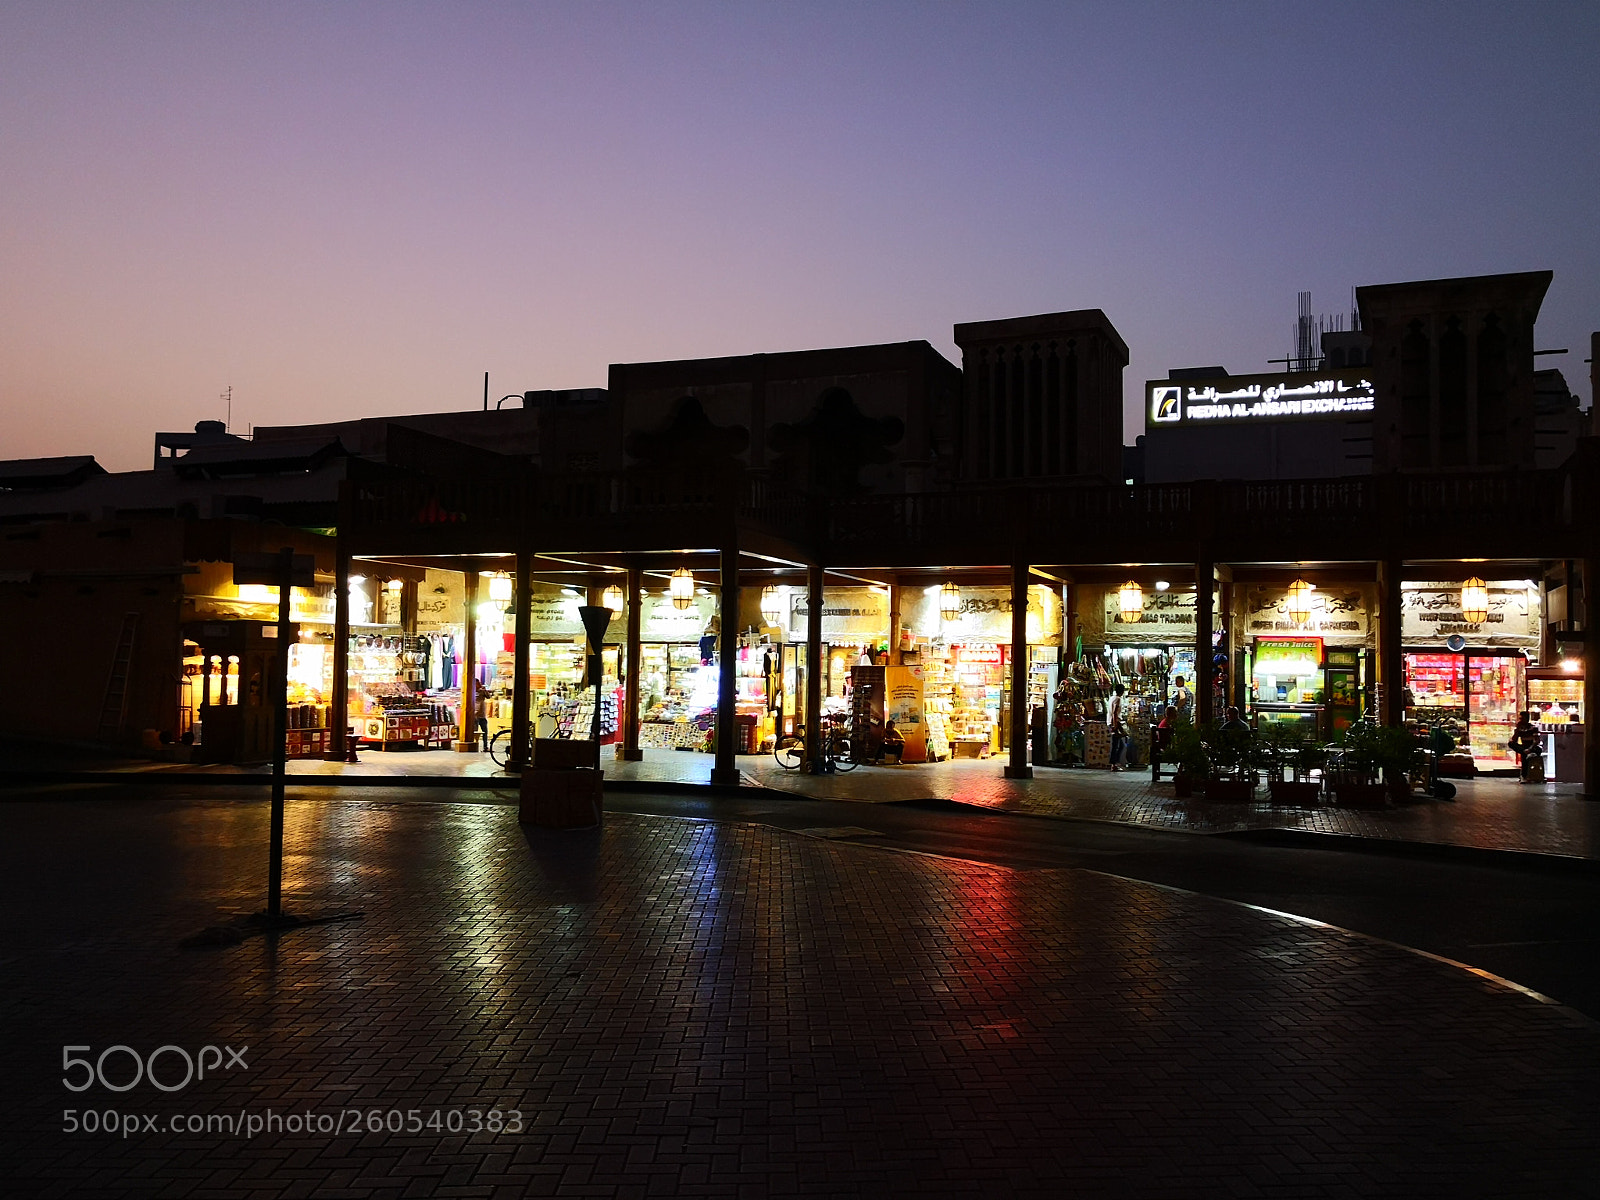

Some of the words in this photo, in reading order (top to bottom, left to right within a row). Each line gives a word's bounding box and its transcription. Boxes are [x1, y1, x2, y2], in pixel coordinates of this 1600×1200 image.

[1187, 403, 1231, 419] REDHA
[1232, 400, 1301, 418] AL-ANSARI
[1301, 397, 1375, 414] EXCHANGE
